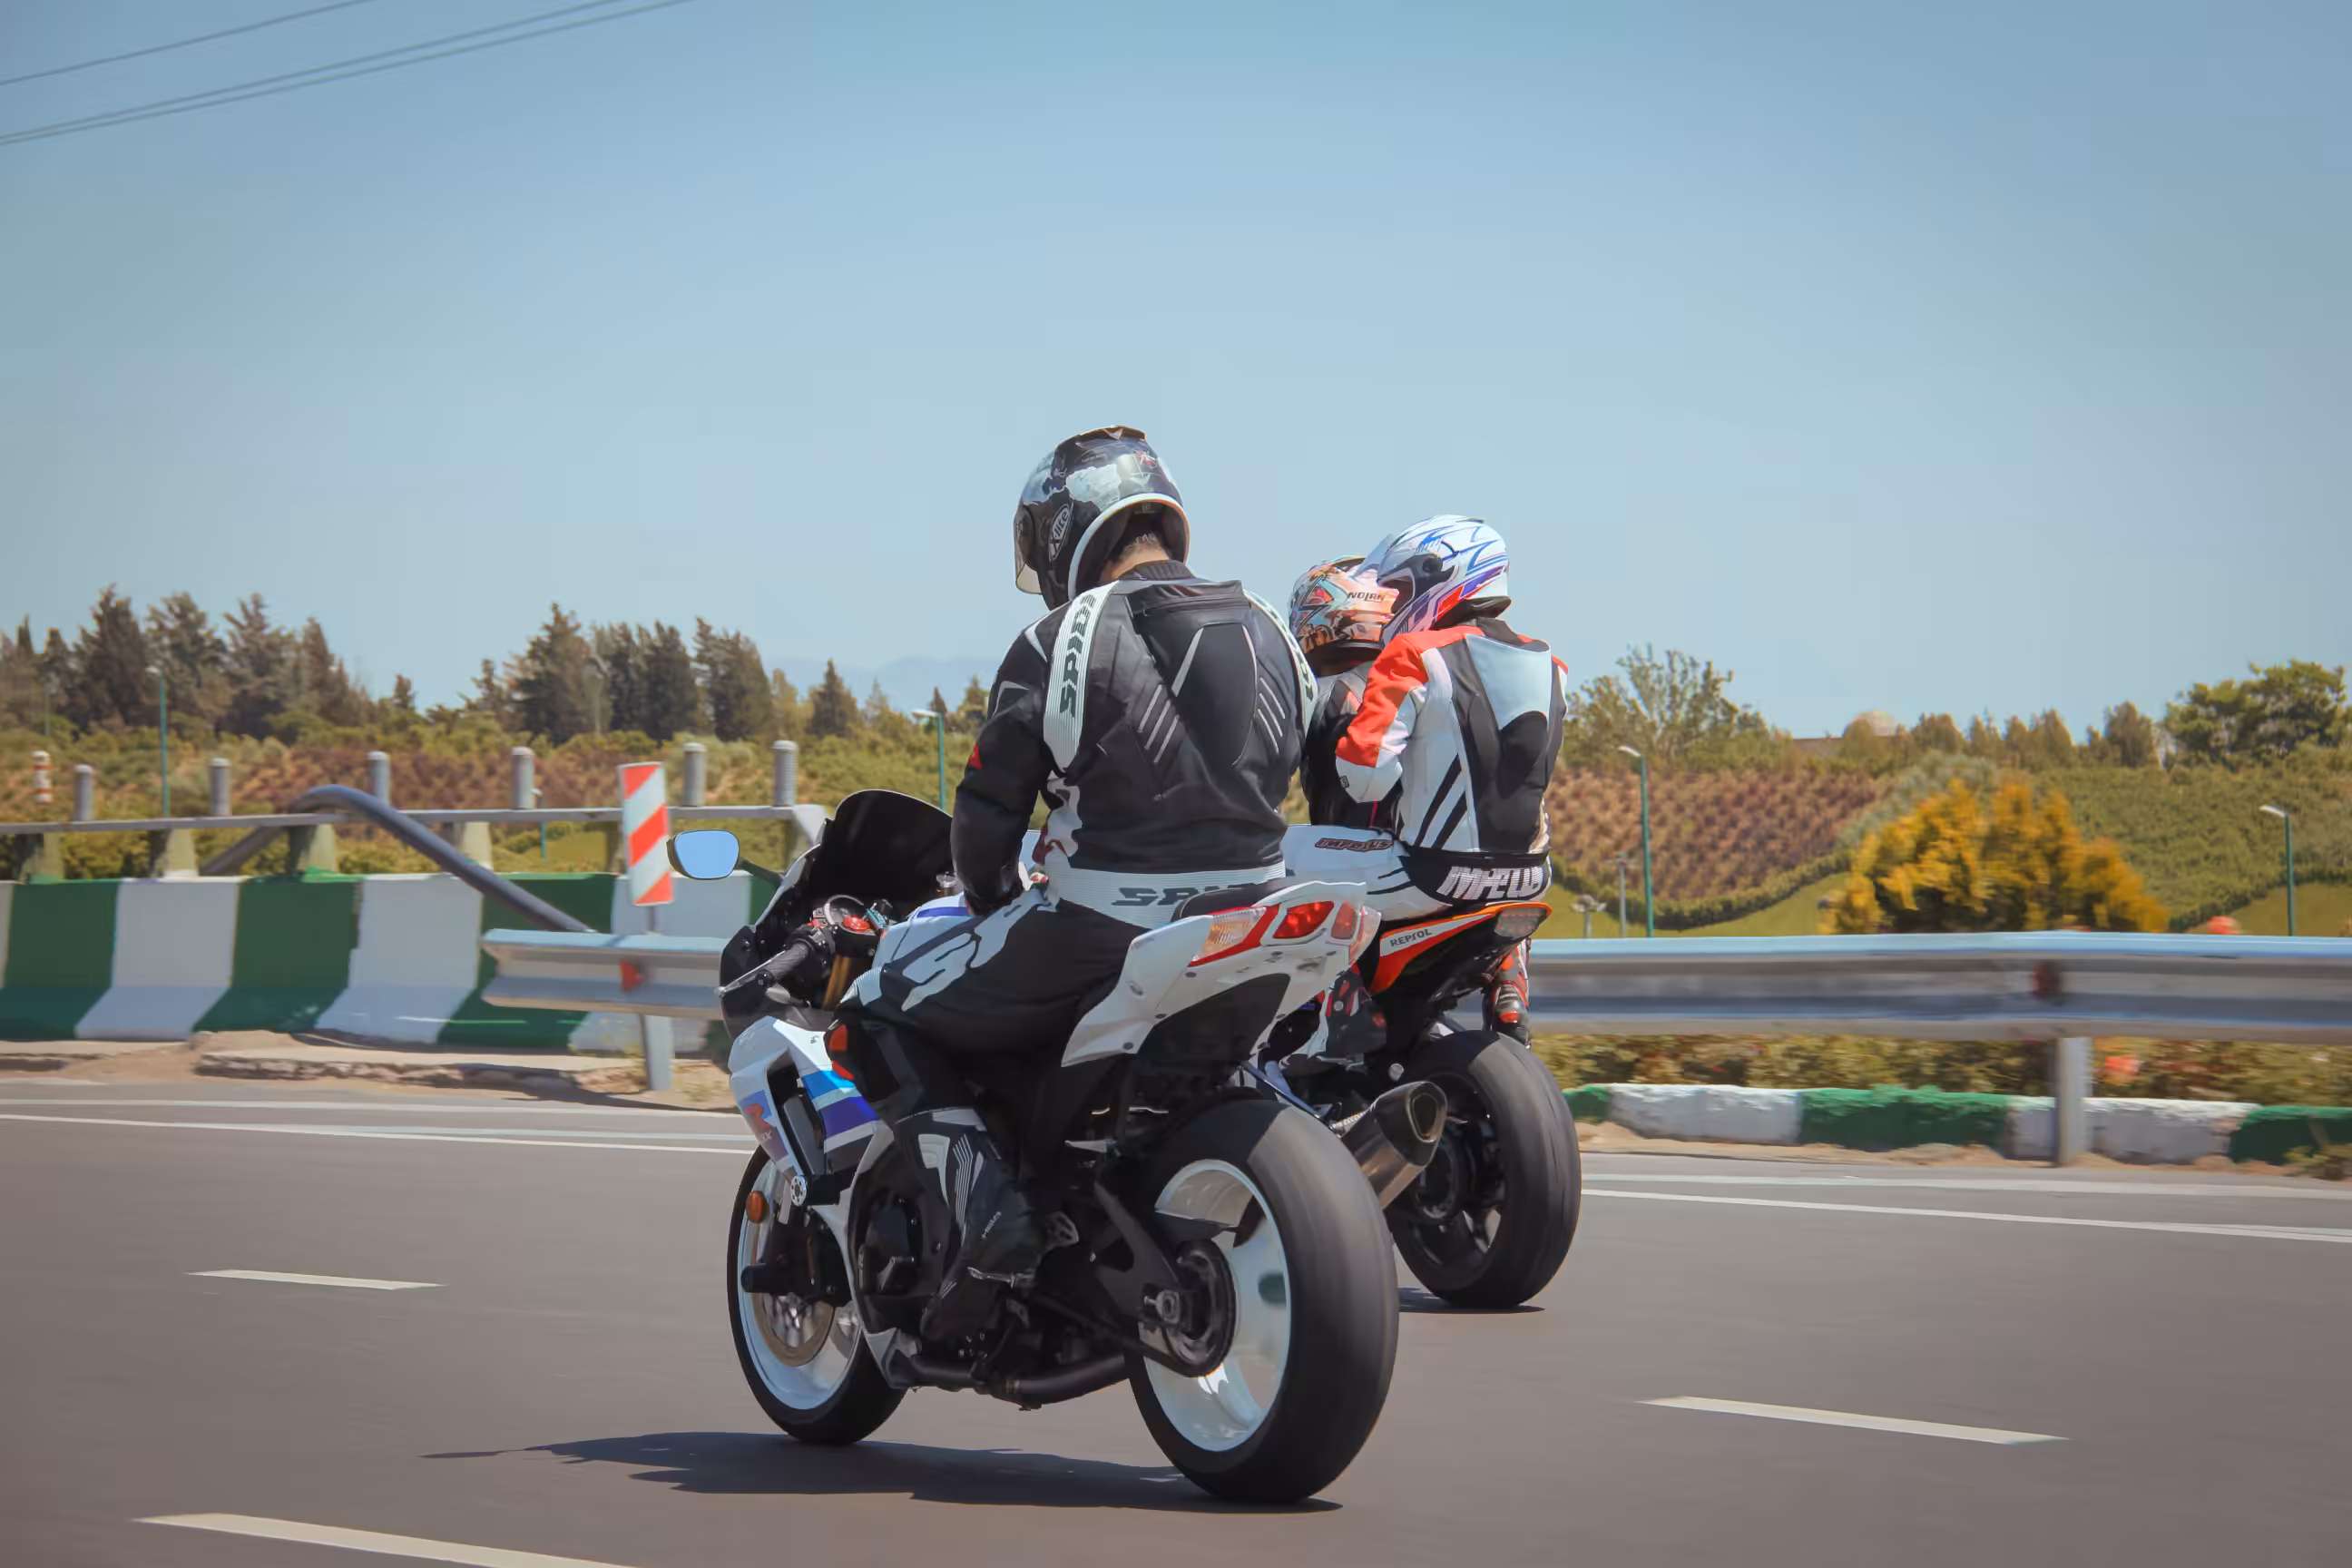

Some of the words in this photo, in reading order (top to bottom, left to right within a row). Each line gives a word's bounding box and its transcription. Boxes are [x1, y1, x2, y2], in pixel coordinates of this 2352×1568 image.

[1347, 592, 1385, 603] NOLAN
[1059, 594, 1096, 718] SPIDI
[1389, 928, 1432, 946] REPSOL
